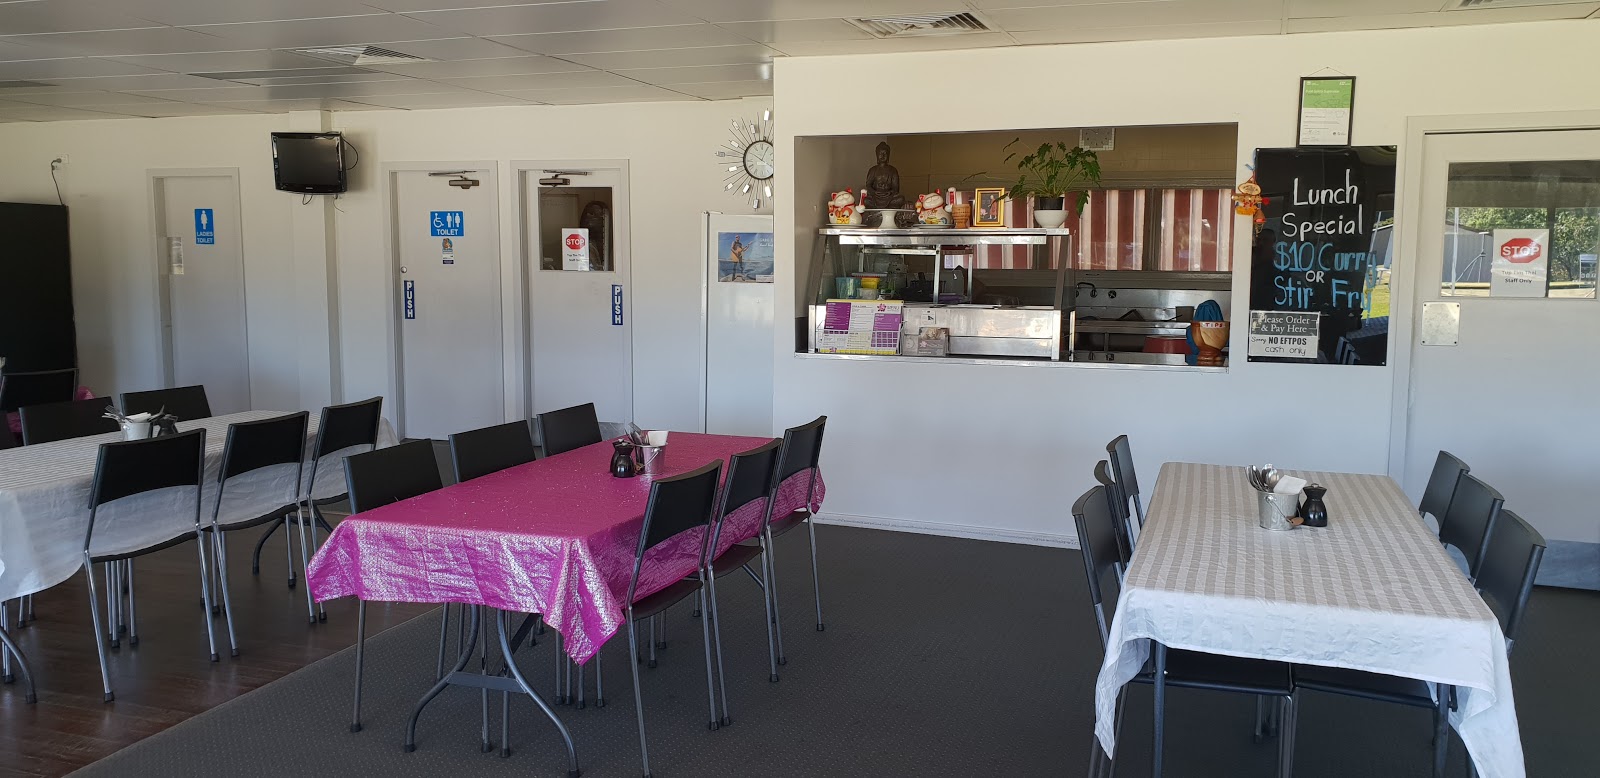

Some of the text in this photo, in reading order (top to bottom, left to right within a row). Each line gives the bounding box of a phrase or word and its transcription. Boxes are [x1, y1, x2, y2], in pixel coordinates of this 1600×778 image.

[1293, 168, 1358, 206] Lunch
[1282, 204, 1363, 241] Special
[566, 238, 585, 246] STOP
[1502, 245, 1540, 257] STOP
[1273, 241, 1377, 289] $10 Curry
[1305, 270, 1325, 283] OR
[406, 281, 414, 318] PUSH
[614, 286, 622, 324] PUSH
[1274, 276, 1372, 324] Stir Fry
[1260, 313, 1311, 324] Please Order
[1261, 323, 1308, 334] & Pay Here
[1268, 336, 1279, 345] NO
[1280, 337, 1307, 346] EFTPOS
